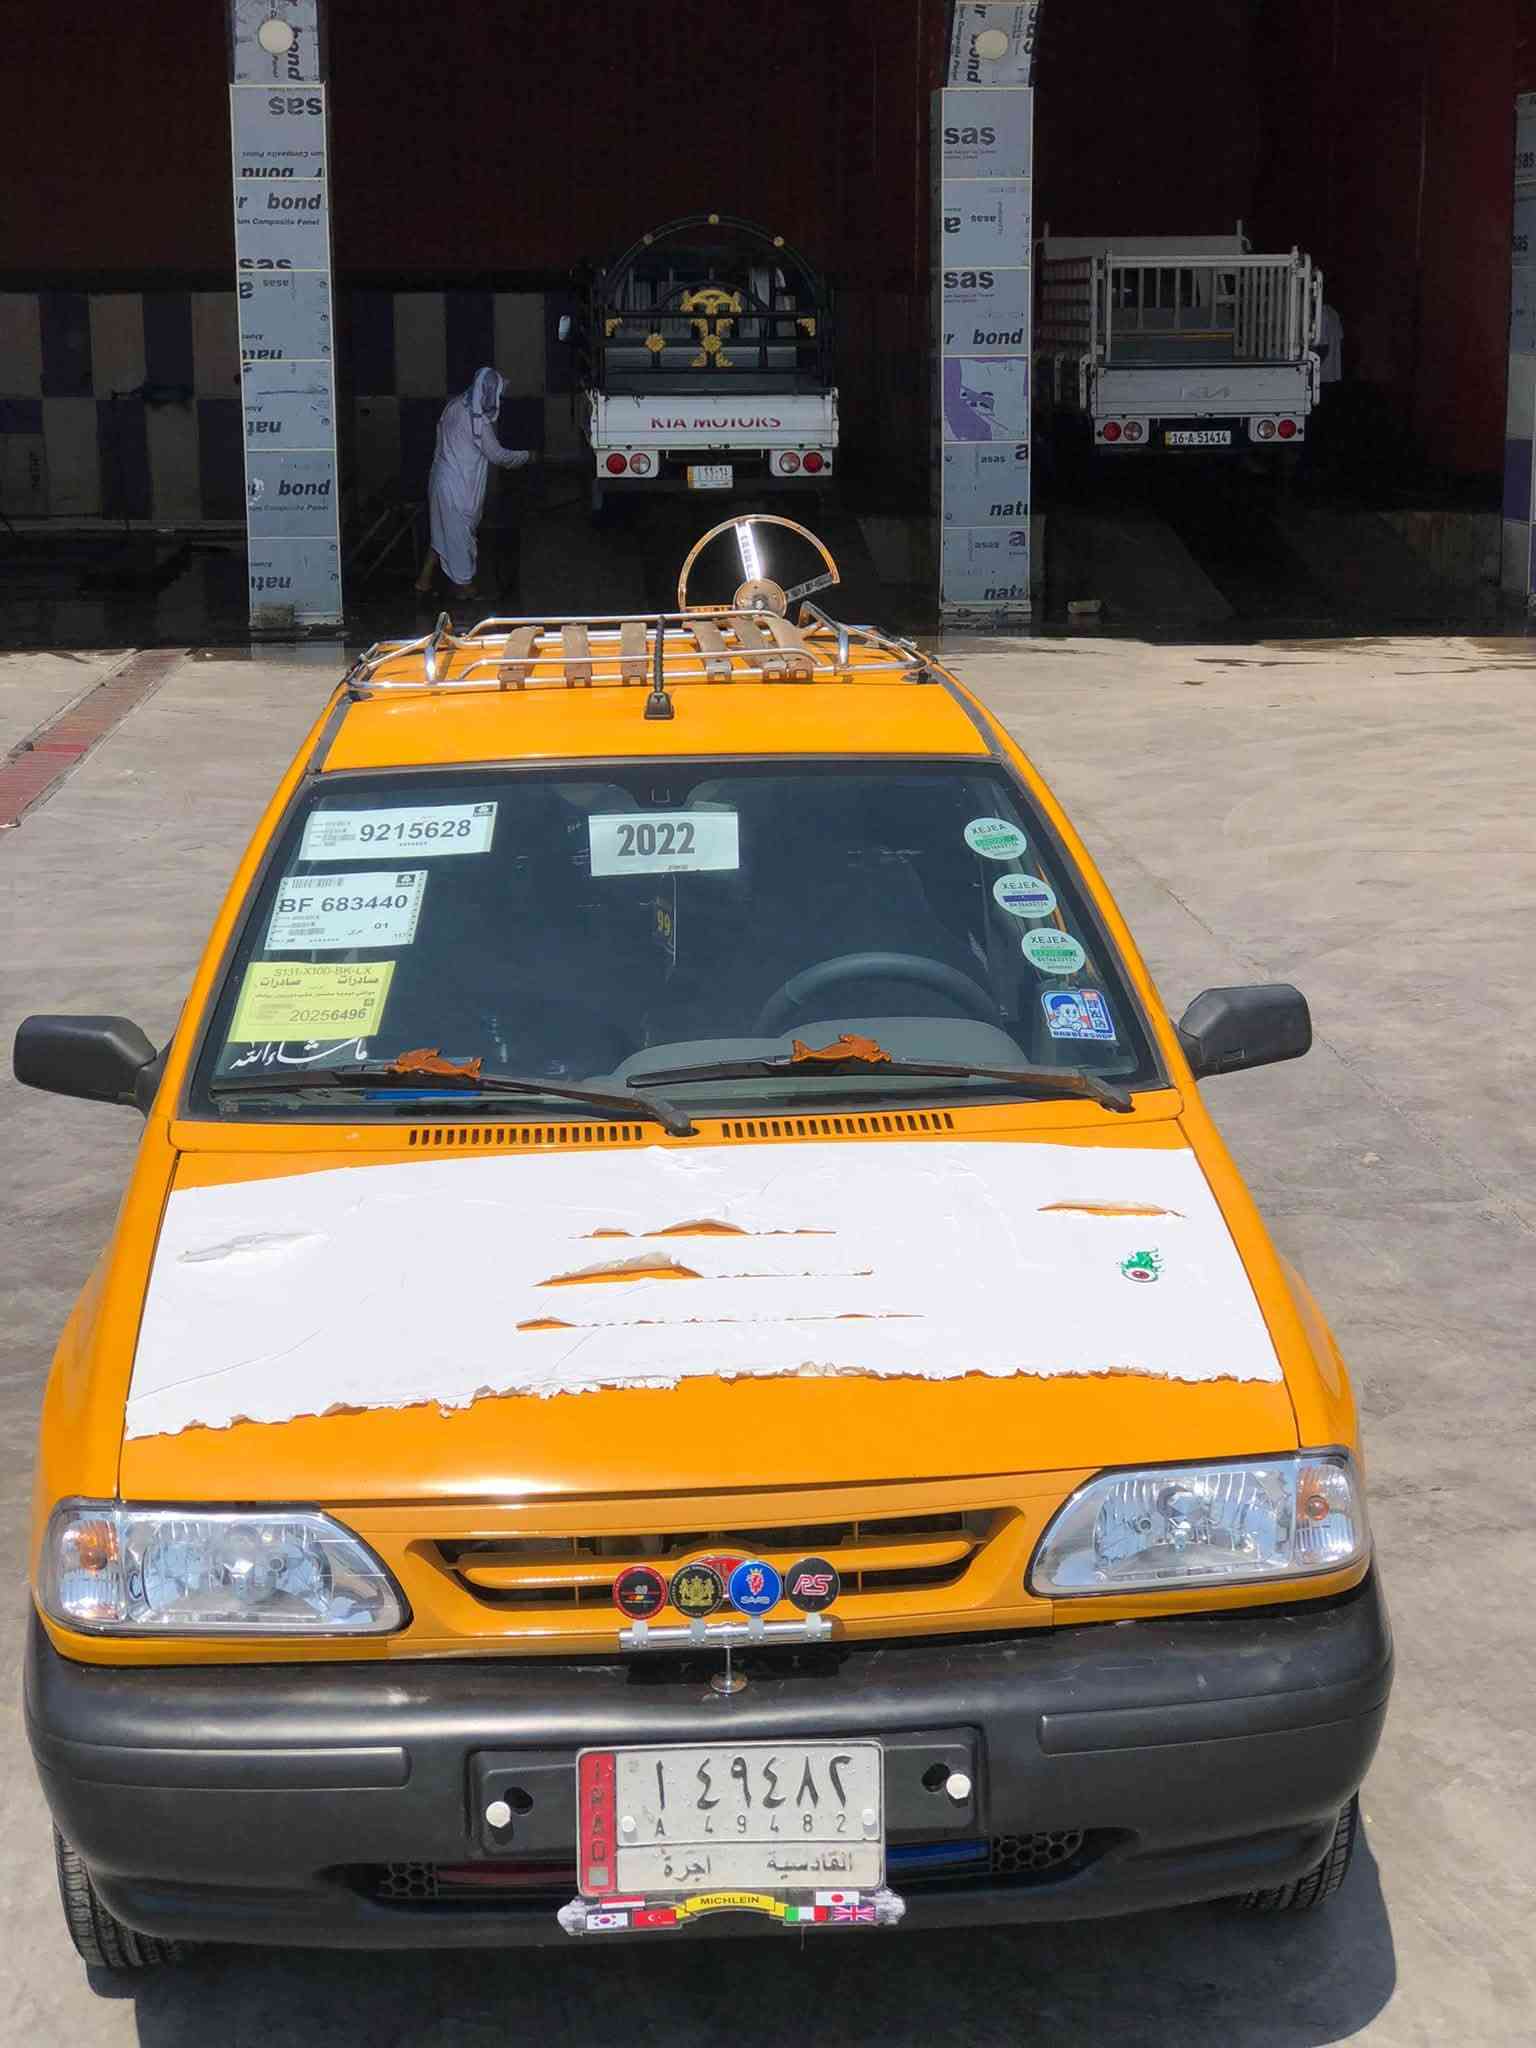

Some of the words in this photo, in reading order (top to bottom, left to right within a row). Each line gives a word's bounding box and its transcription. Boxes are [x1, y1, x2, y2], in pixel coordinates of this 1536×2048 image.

[943, 126, 996, 145] sas
[267, 193, 322, 209] bond
[943, 271, 994, 289] sas
[972, 328, 1024, 345] bond
[650, 416, 687, 429] KIA
[693, 416, 781, 429] MOTORS
[278, 480, 331, 495] bond
[359, 819, 472, 842] 9215628
[617, 822, 696, 856] 2022
[279, 898, 314, 912] BF
[321, 895, 408, 912] 683440
[767, 1850, 853, 1880] القادسية
